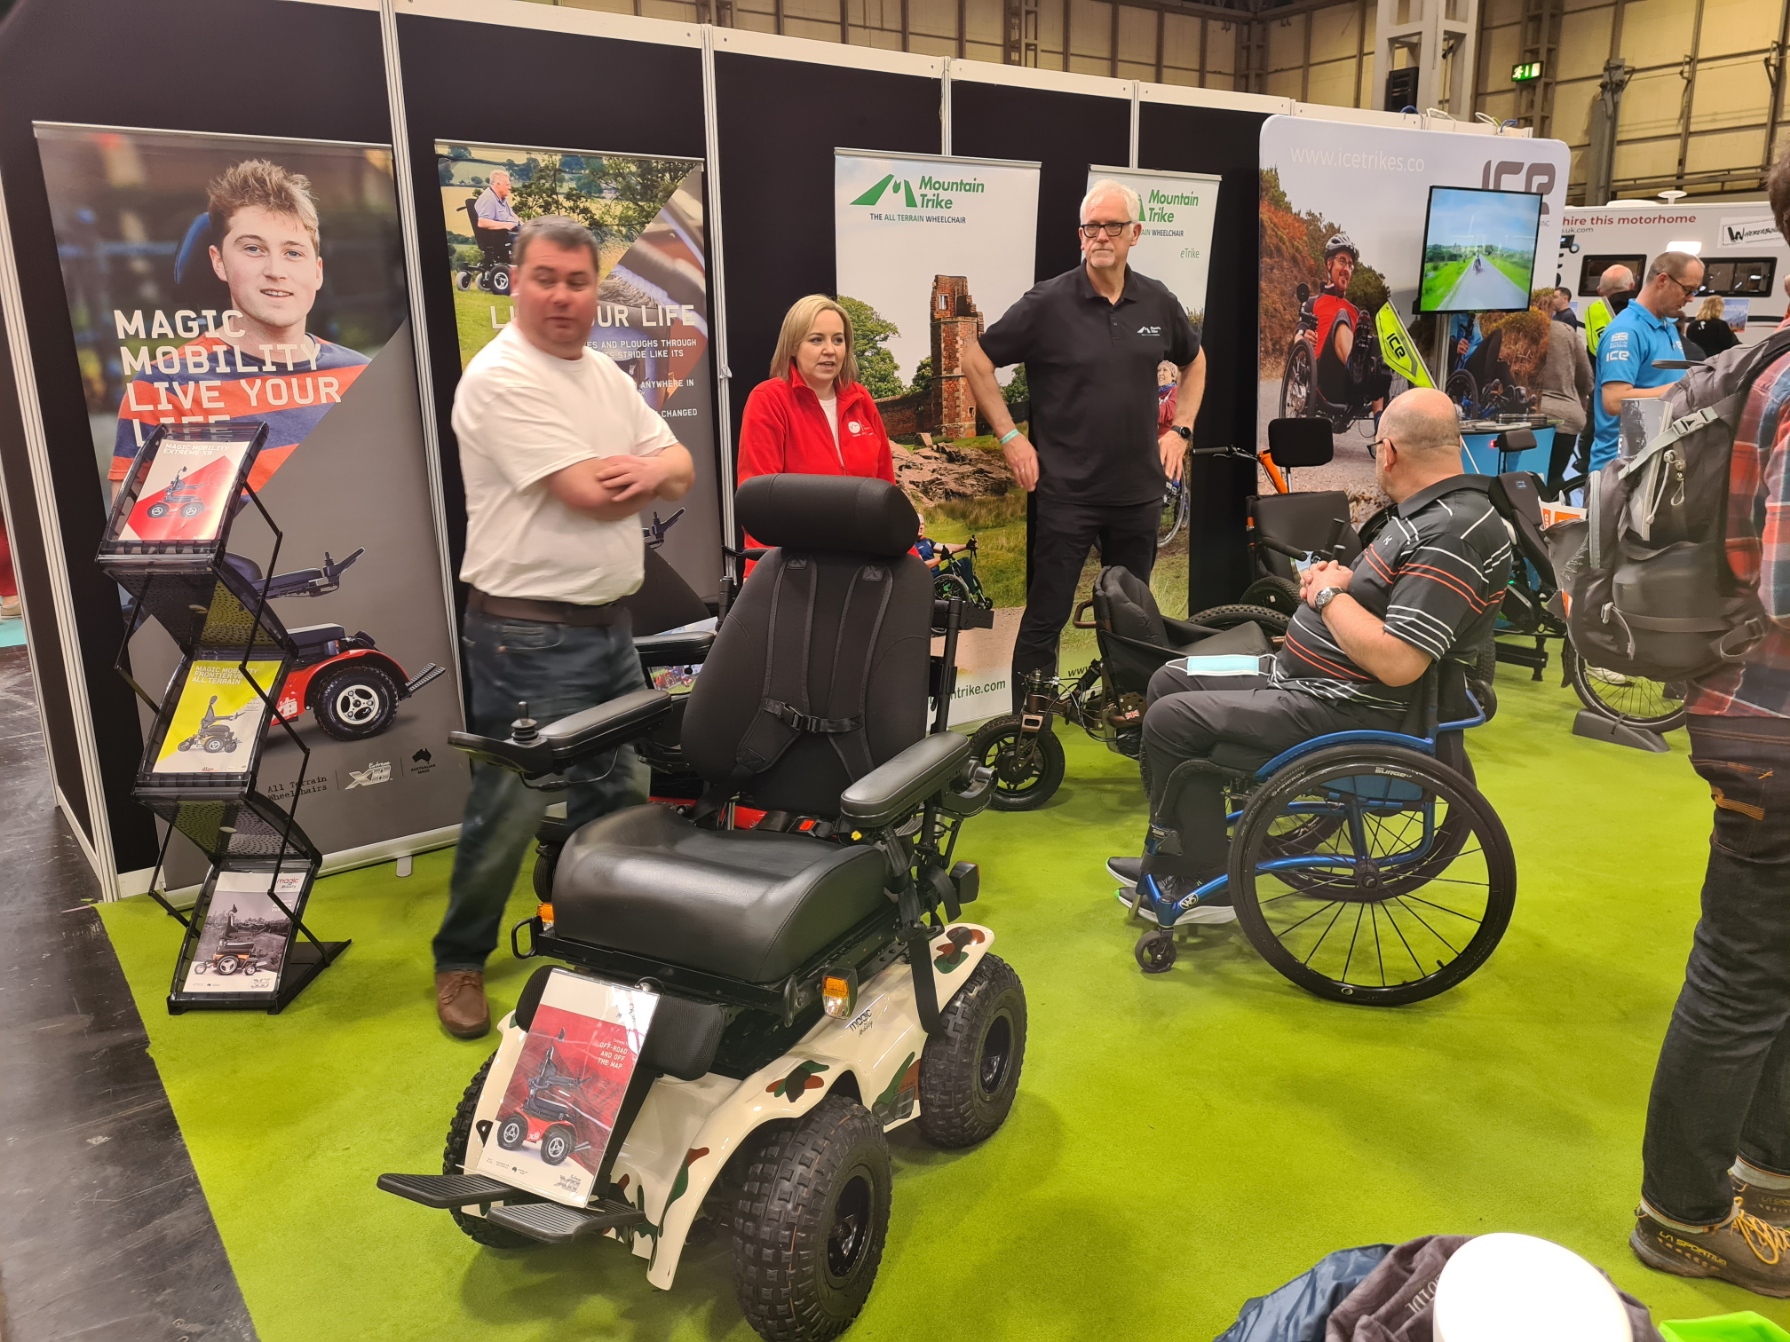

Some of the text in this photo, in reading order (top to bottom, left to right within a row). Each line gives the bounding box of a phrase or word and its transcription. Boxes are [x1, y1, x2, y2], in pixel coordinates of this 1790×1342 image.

[1290, 147, 1425, 172] www.icetrikes.co
[919, 175, 985, 193] Mountain
[920, 193, 953, 209] Trike
[1148, 189, 1199, 206] Mountain
[870, 212, 966, 224] THE ALL TERRAIN WHEELCHAIR
[1148, 206, 1175, 223] Trike
[1562, 214, 1697, 226] hire this motorhome
[1151, 229, 1184, 237] WHEELCHAIR
[1180, 248, 1200, 259] eTrike
[641, 304, 696, 327] LIFE
[114, 309, 246, 339] MAGIC
[601, 341, 617, 349] AND
[621, 340, 658, 348] PLOUGHS
[661, 338, 697, 347] THROUGH
[120, 343, 321, 375] MOBILITY
[618, 350, 646, 358] STRIDE
[650, 350, 668, 358] LIKE
[671, 349, 684, 357] ITS
[640, 379, 694, 388] ANYWHERE IN
[127, 376, 342, 411] LIVE YOUR
[661, 408, 698, 417] CHANGED
[193, 671, 233, 679] FRONTIER
[196, 665, 220, 673] MAGIC
[192, 676, 206, 684] ALL
[267, 783, 284, 794] All
[599, 1041, 628, 1055] OFF-ROAD
[600, 1050, 626, 1062] AND OFF
[598, 1057, 623, 1069] THE MAP
